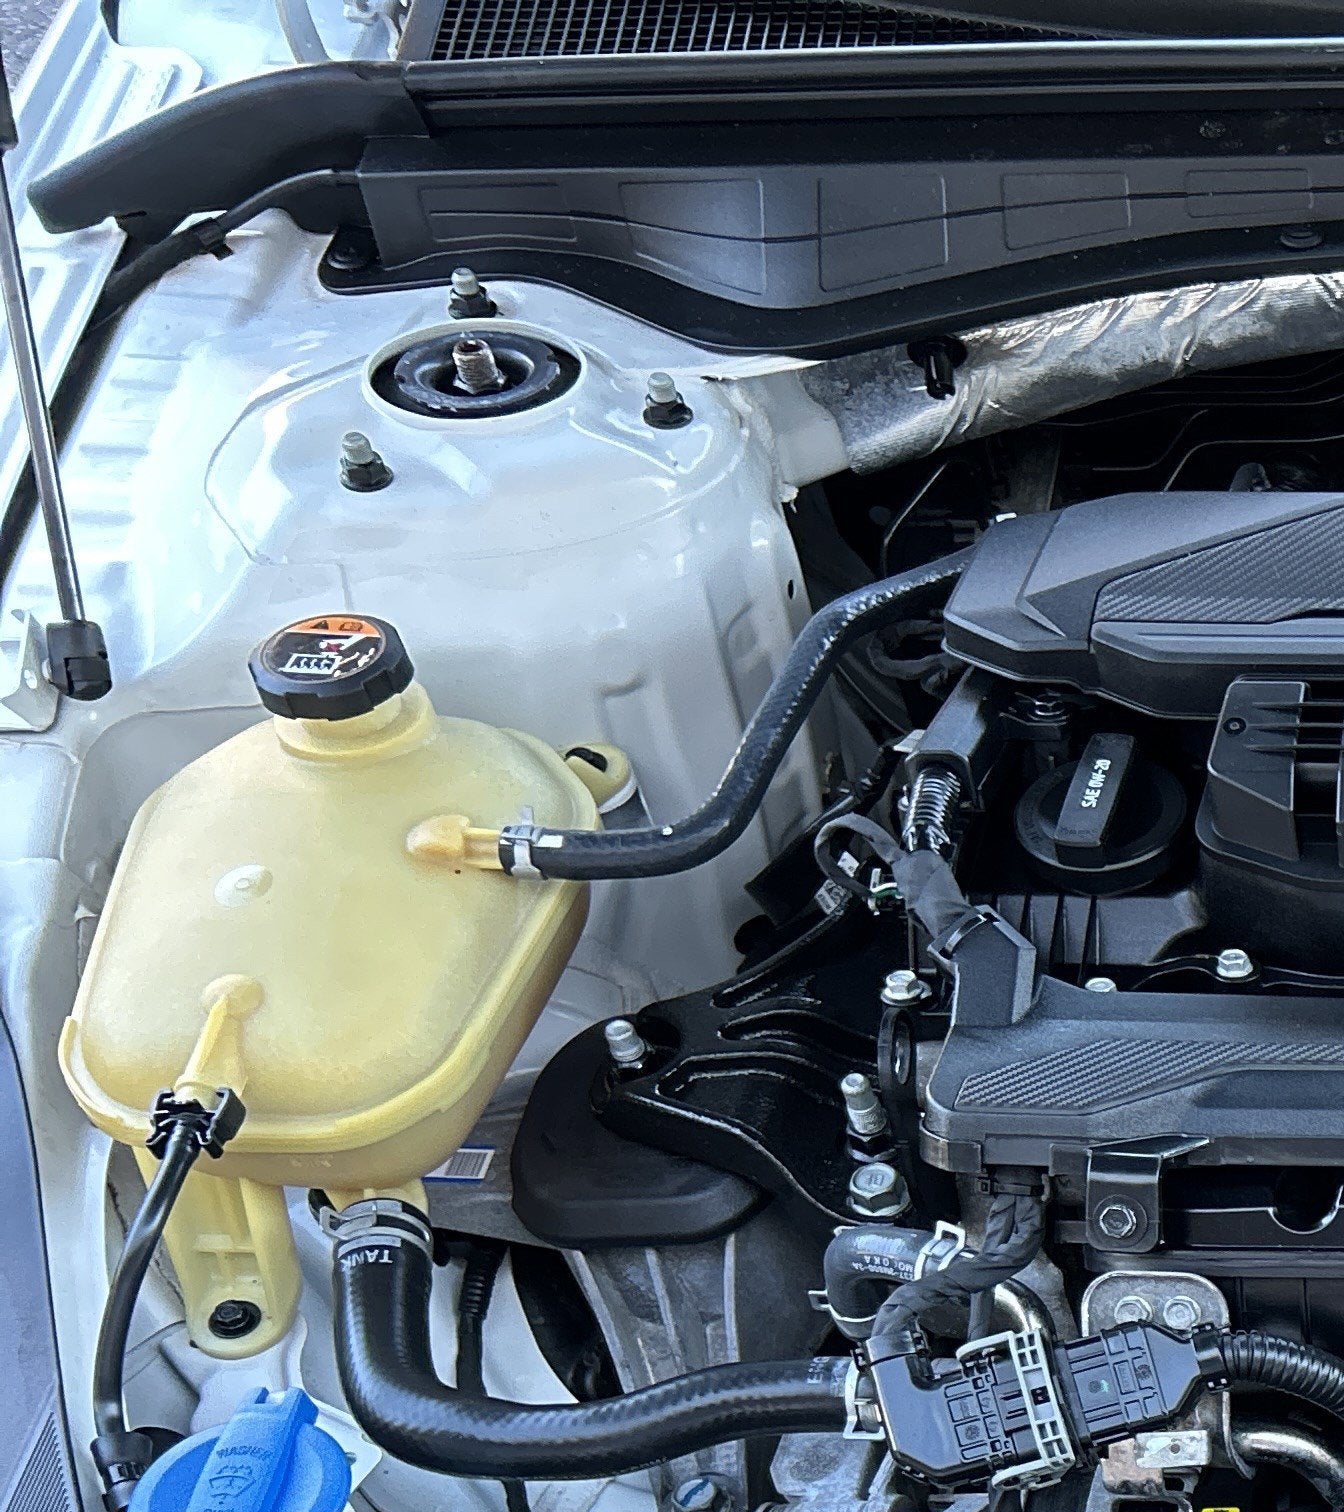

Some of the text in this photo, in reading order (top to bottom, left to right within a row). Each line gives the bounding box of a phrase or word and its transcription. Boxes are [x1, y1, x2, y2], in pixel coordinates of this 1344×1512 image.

[1081, 758, 1112, 808] SAE 0W-20
[339, 1248, 394, 1273] TANK
[215, 1444, 274, 1462] WASHER
